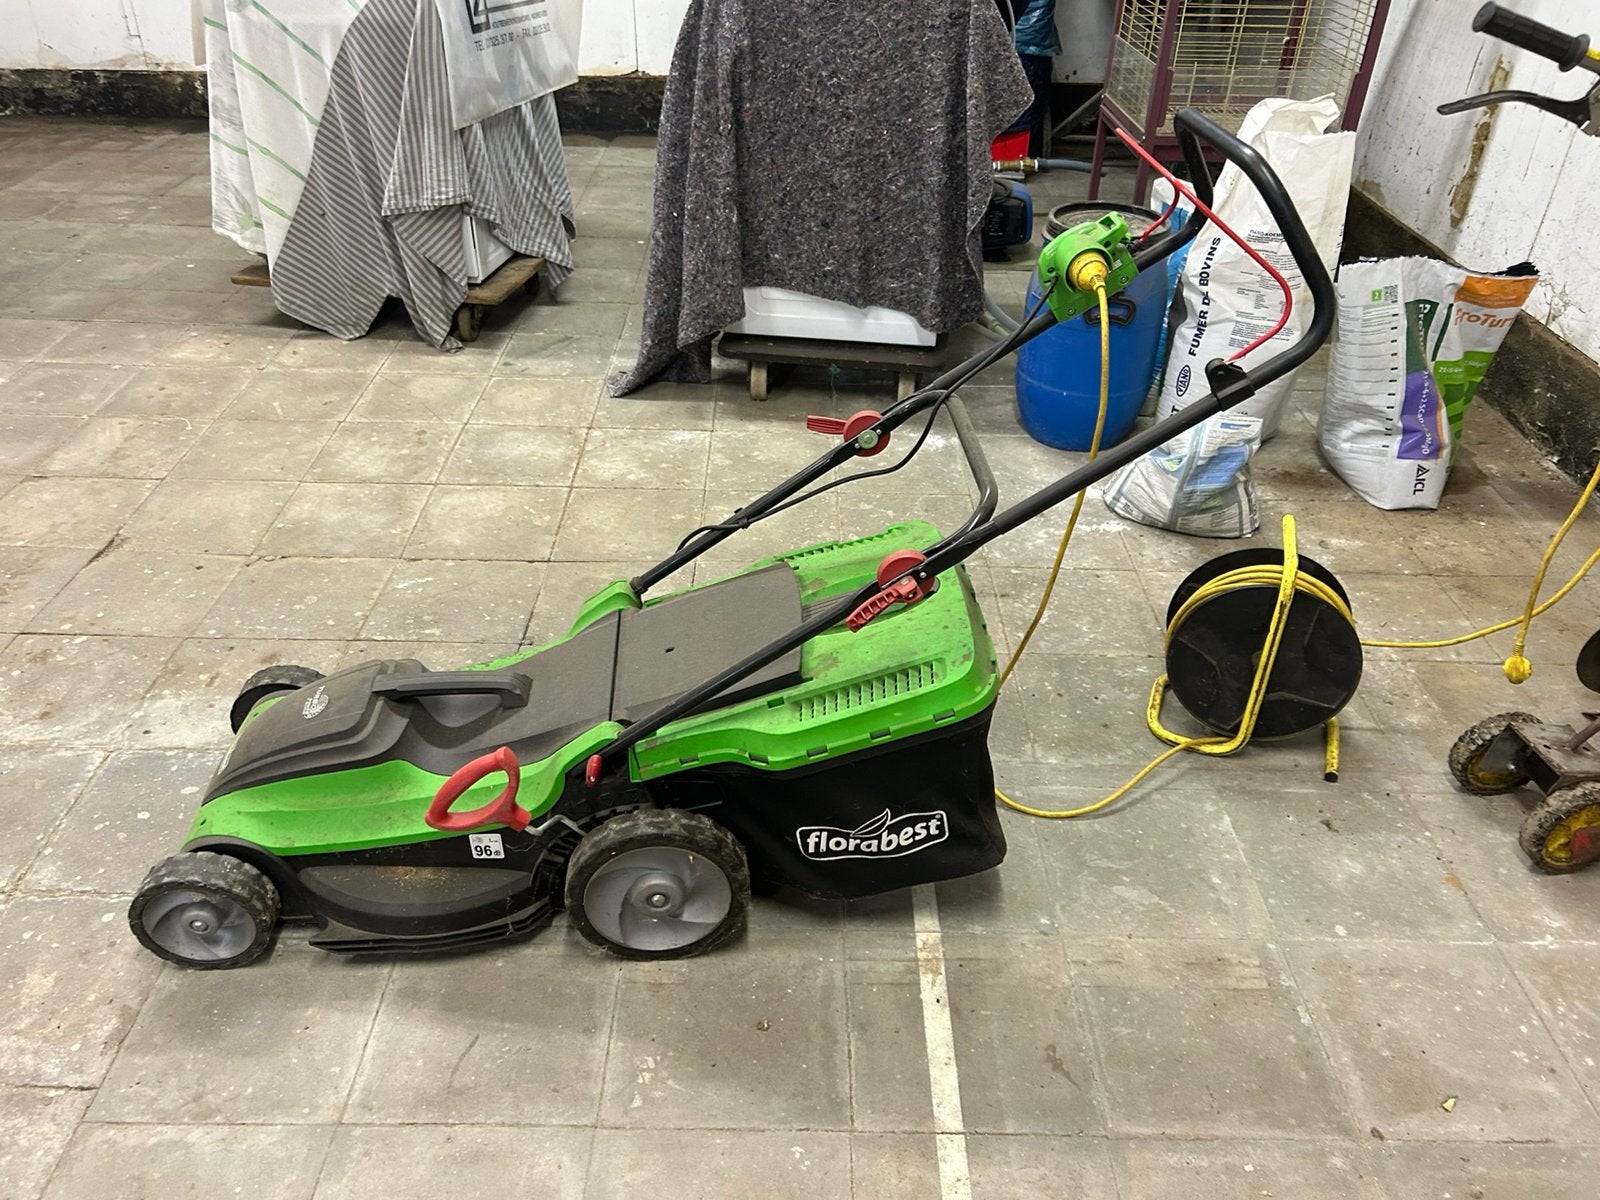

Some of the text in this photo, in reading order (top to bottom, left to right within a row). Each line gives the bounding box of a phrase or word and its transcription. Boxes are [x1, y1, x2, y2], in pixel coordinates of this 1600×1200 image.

[1198, 236, 1222, 287] BOVINS
[1454, 307, 1516, 329] ProTur
[1188, 309, 1209, 357] FUMER
[1177, 367, 1190, 393] VIANO
[1412, 478, 1426, 496] ICL
[806, 817, 942, 854] florabest
[474, 844, 493, 857] 96
